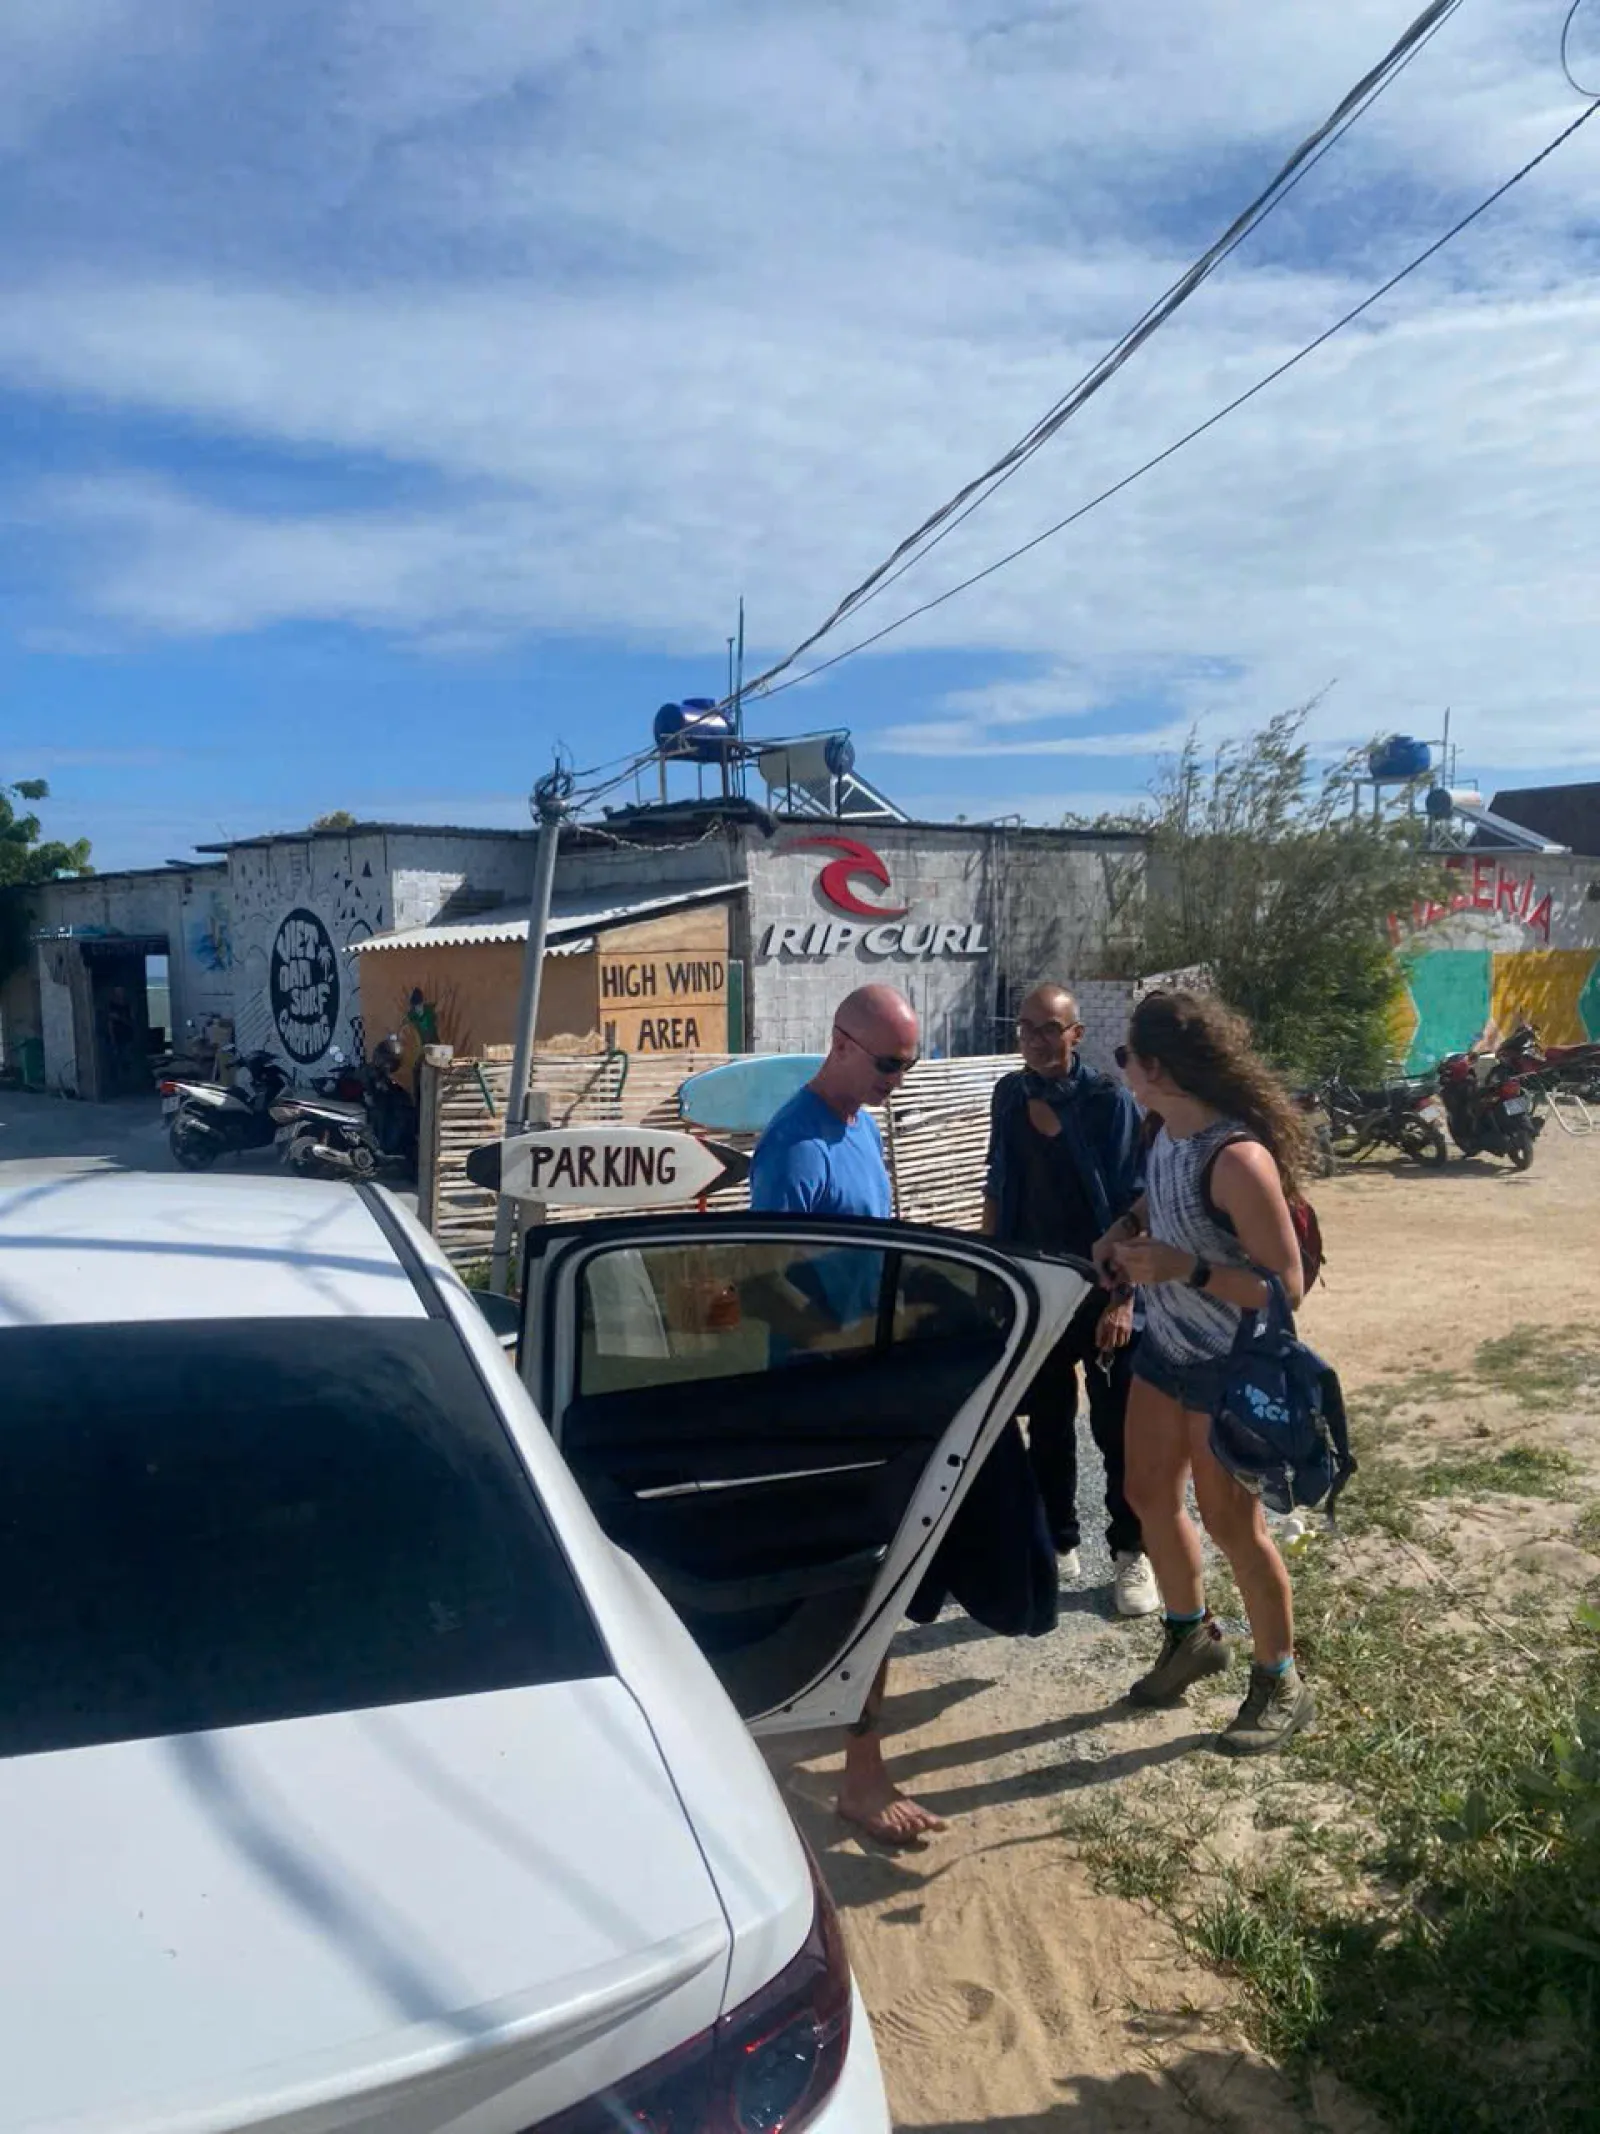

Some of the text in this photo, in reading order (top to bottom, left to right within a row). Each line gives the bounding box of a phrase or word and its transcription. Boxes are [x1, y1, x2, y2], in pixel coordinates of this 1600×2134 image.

[277, 919, 319, 964] VIET
[766, 923, 990, 956] RIP CURL
[601, 961, 725, 998] HIGH WIND
[291, 983, 331, 1016] SURF
[637, 1017, 701, 1051] AREA
[530, 1145, 677, 1188] PARKING
